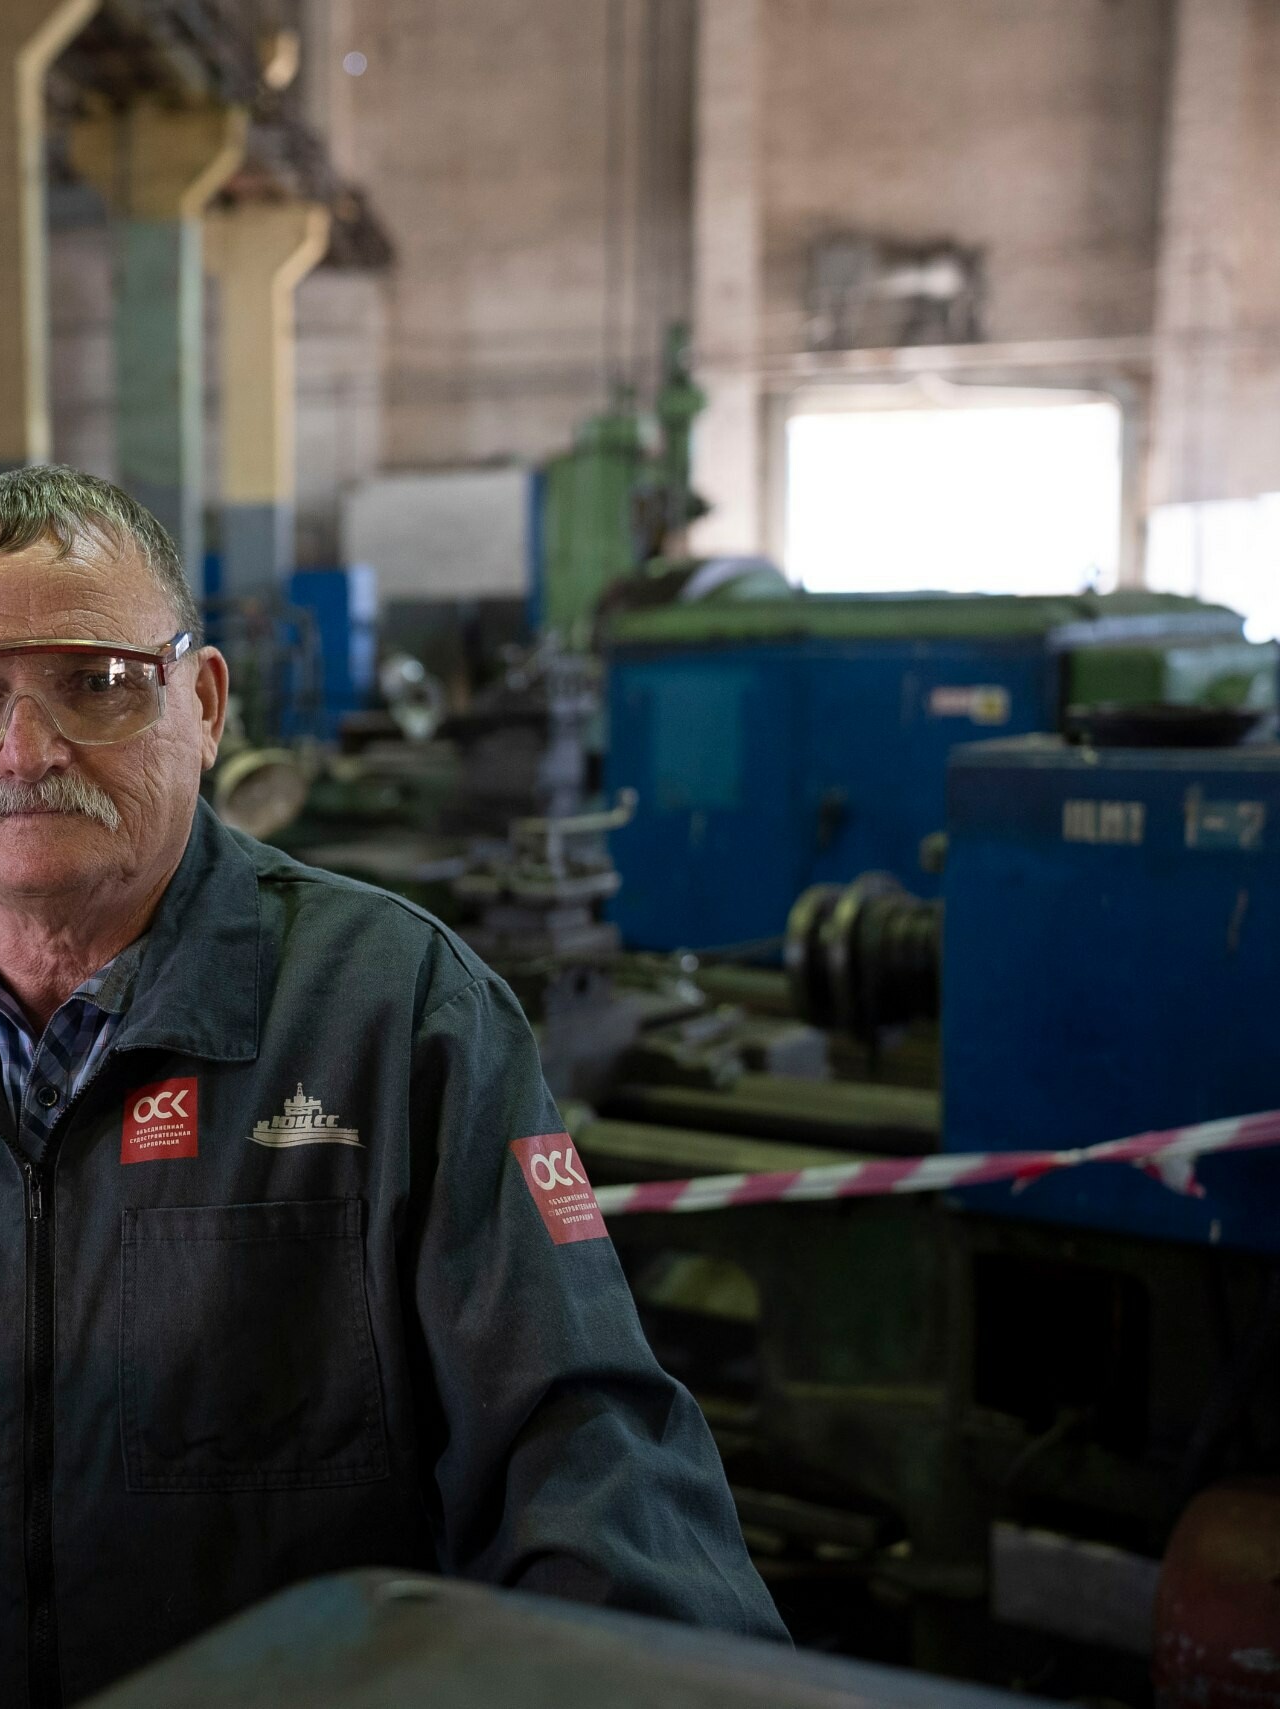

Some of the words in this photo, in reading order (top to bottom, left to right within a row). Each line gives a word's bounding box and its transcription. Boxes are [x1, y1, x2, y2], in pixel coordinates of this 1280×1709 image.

[133, 1089, 190, 1124] ОСК
[271, 1114, 340, 1130] ЮЦСС
[129, 1130, 191, 1144] СУДОСТРОИТЕЛЬНАЯ
[139, 1139, 180, 1149] КОРПОРАЦИЯ
[530, 1147, 586, 1191] ОСК
[548, 1202, 598, 1217] ДОСТРОИТЕЛЬНАЯ
[562, 1212, 594, 1225] КОРПОРАЦИЯ
